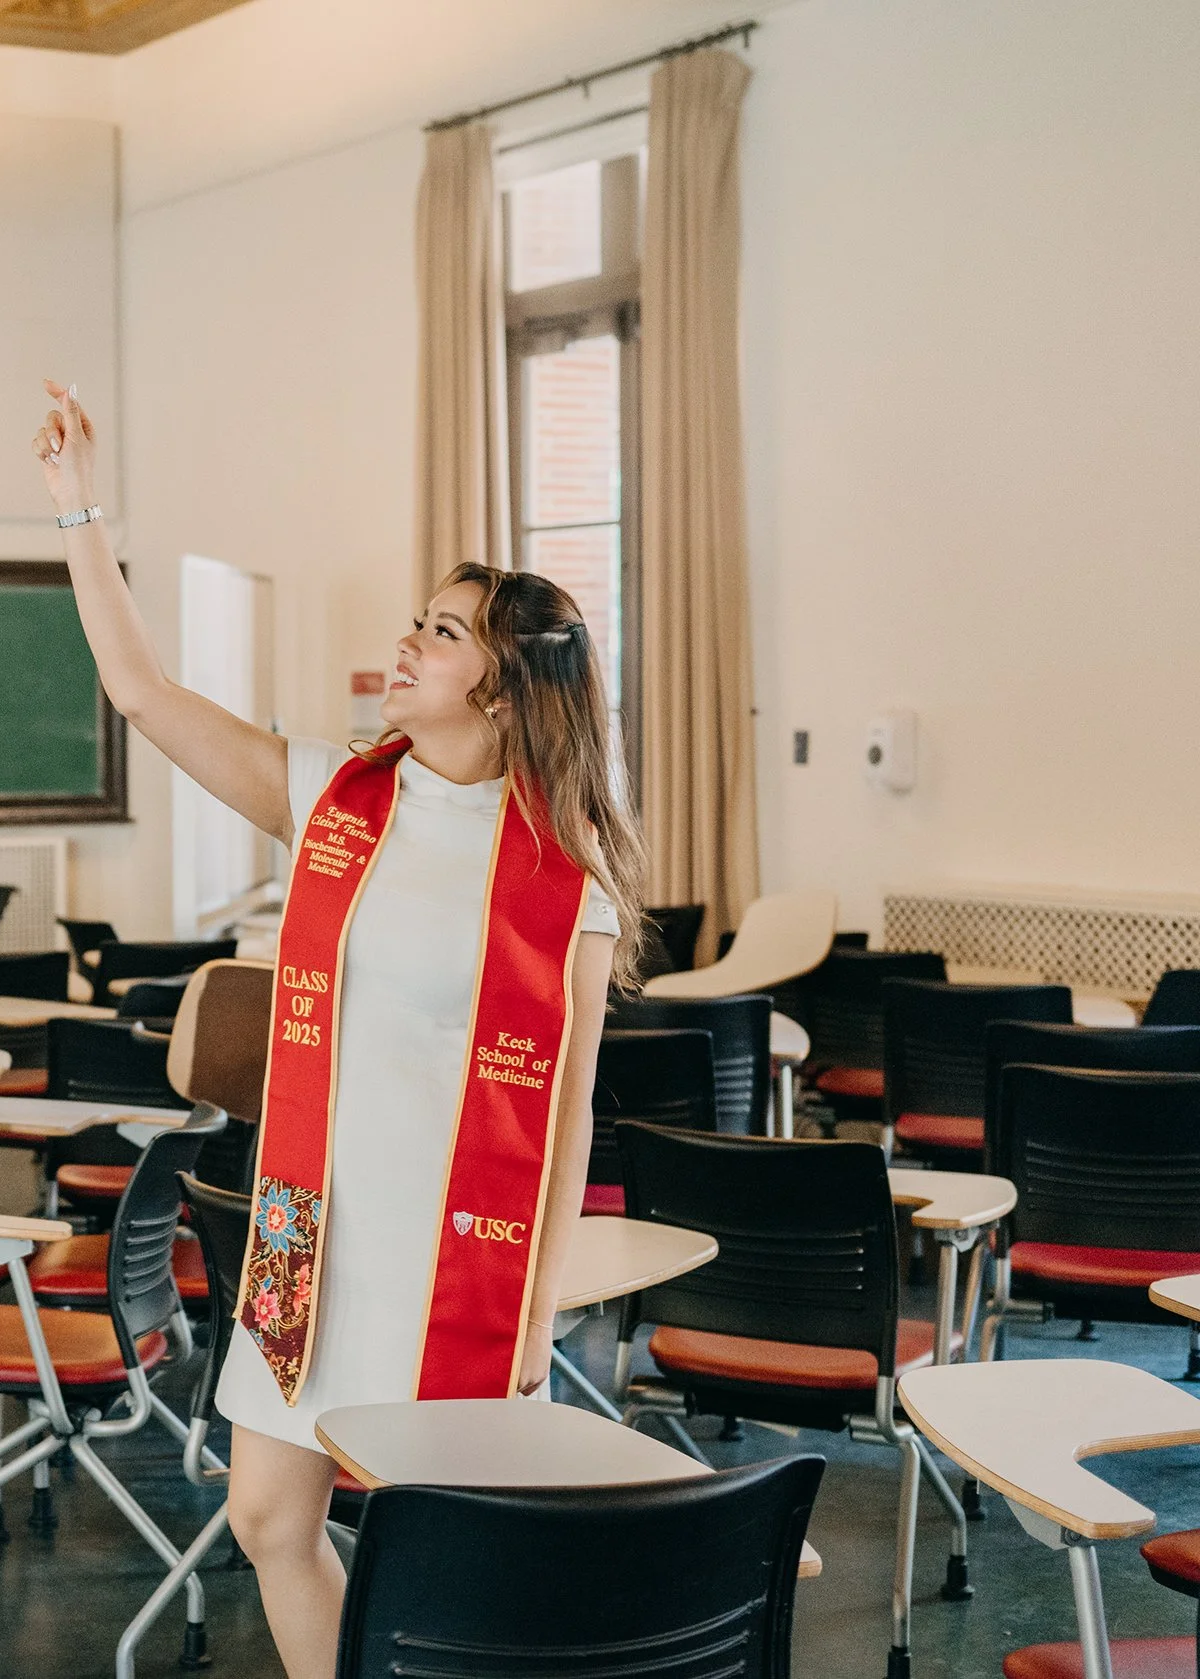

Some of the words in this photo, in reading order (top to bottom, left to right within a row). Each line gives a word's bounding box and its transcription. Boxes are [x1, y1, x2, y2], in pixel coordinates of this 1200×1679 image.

[326, 806, 368, 827] Eugenia
[343, 824, 377, 844] Turino
[304, 838, 355, 861] Biochemistry
[356, 855, 366, 865] &
[309, 850, 350, 869] Molecular
[307, 861, 344, 878] Medicine
[283, 965, 328, 993] CLASS
[291, 995, 314, 1017] OF
[282, 1019, 321, 1047] 2025
[496, 1031, 536, 1053] Keck
[477, 1046, 525, 1068] School
[532, 1059, 552, 1073] of
[477, 1064, 545, 1089] Medicine
[473, 1216, 526, 1244] USC
